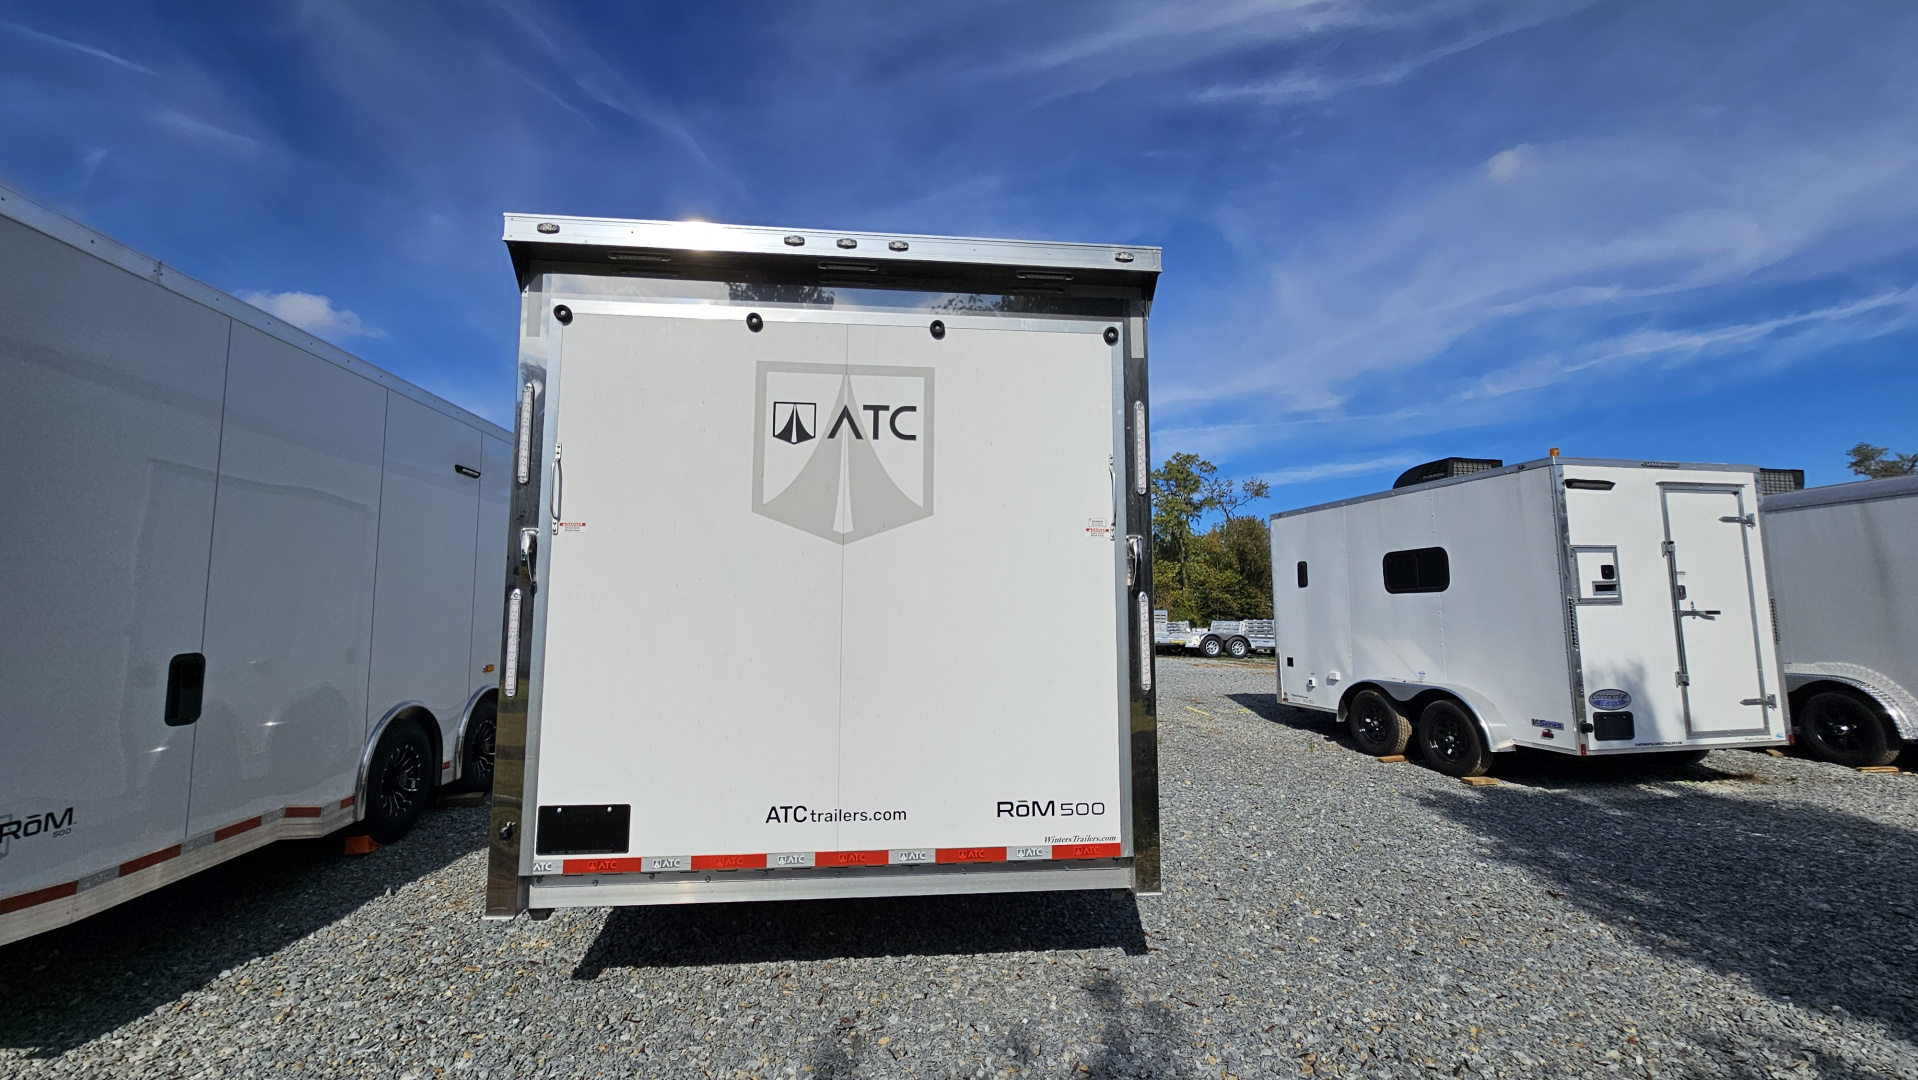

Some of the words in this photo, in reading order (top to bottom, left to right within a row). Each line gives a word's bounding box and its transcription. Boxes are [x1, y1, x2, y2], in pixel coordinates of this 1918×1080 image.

[827, 404, 917, 441] ATC
[1061, 802, 1105, 816] 500
[52, 827, 72, 838] 500
[1043, 834, 1117, 844] WintersTrailers.com
[533, 862, 552, 871] ATC
[598, 860, 617, 870] ATC
[662, 859, 680, 868] ATC
[724, 857, 743, 866] ATC
[787, 855, 805, 864] ATC
[848, 853, 866, 862] ATC
[908, 851, 926, 860] ATC
[968, 849, 985, 858] ATC
[1025, 848, 1042, 857] ATC
[1083, 846, 1100, 855] ATC
